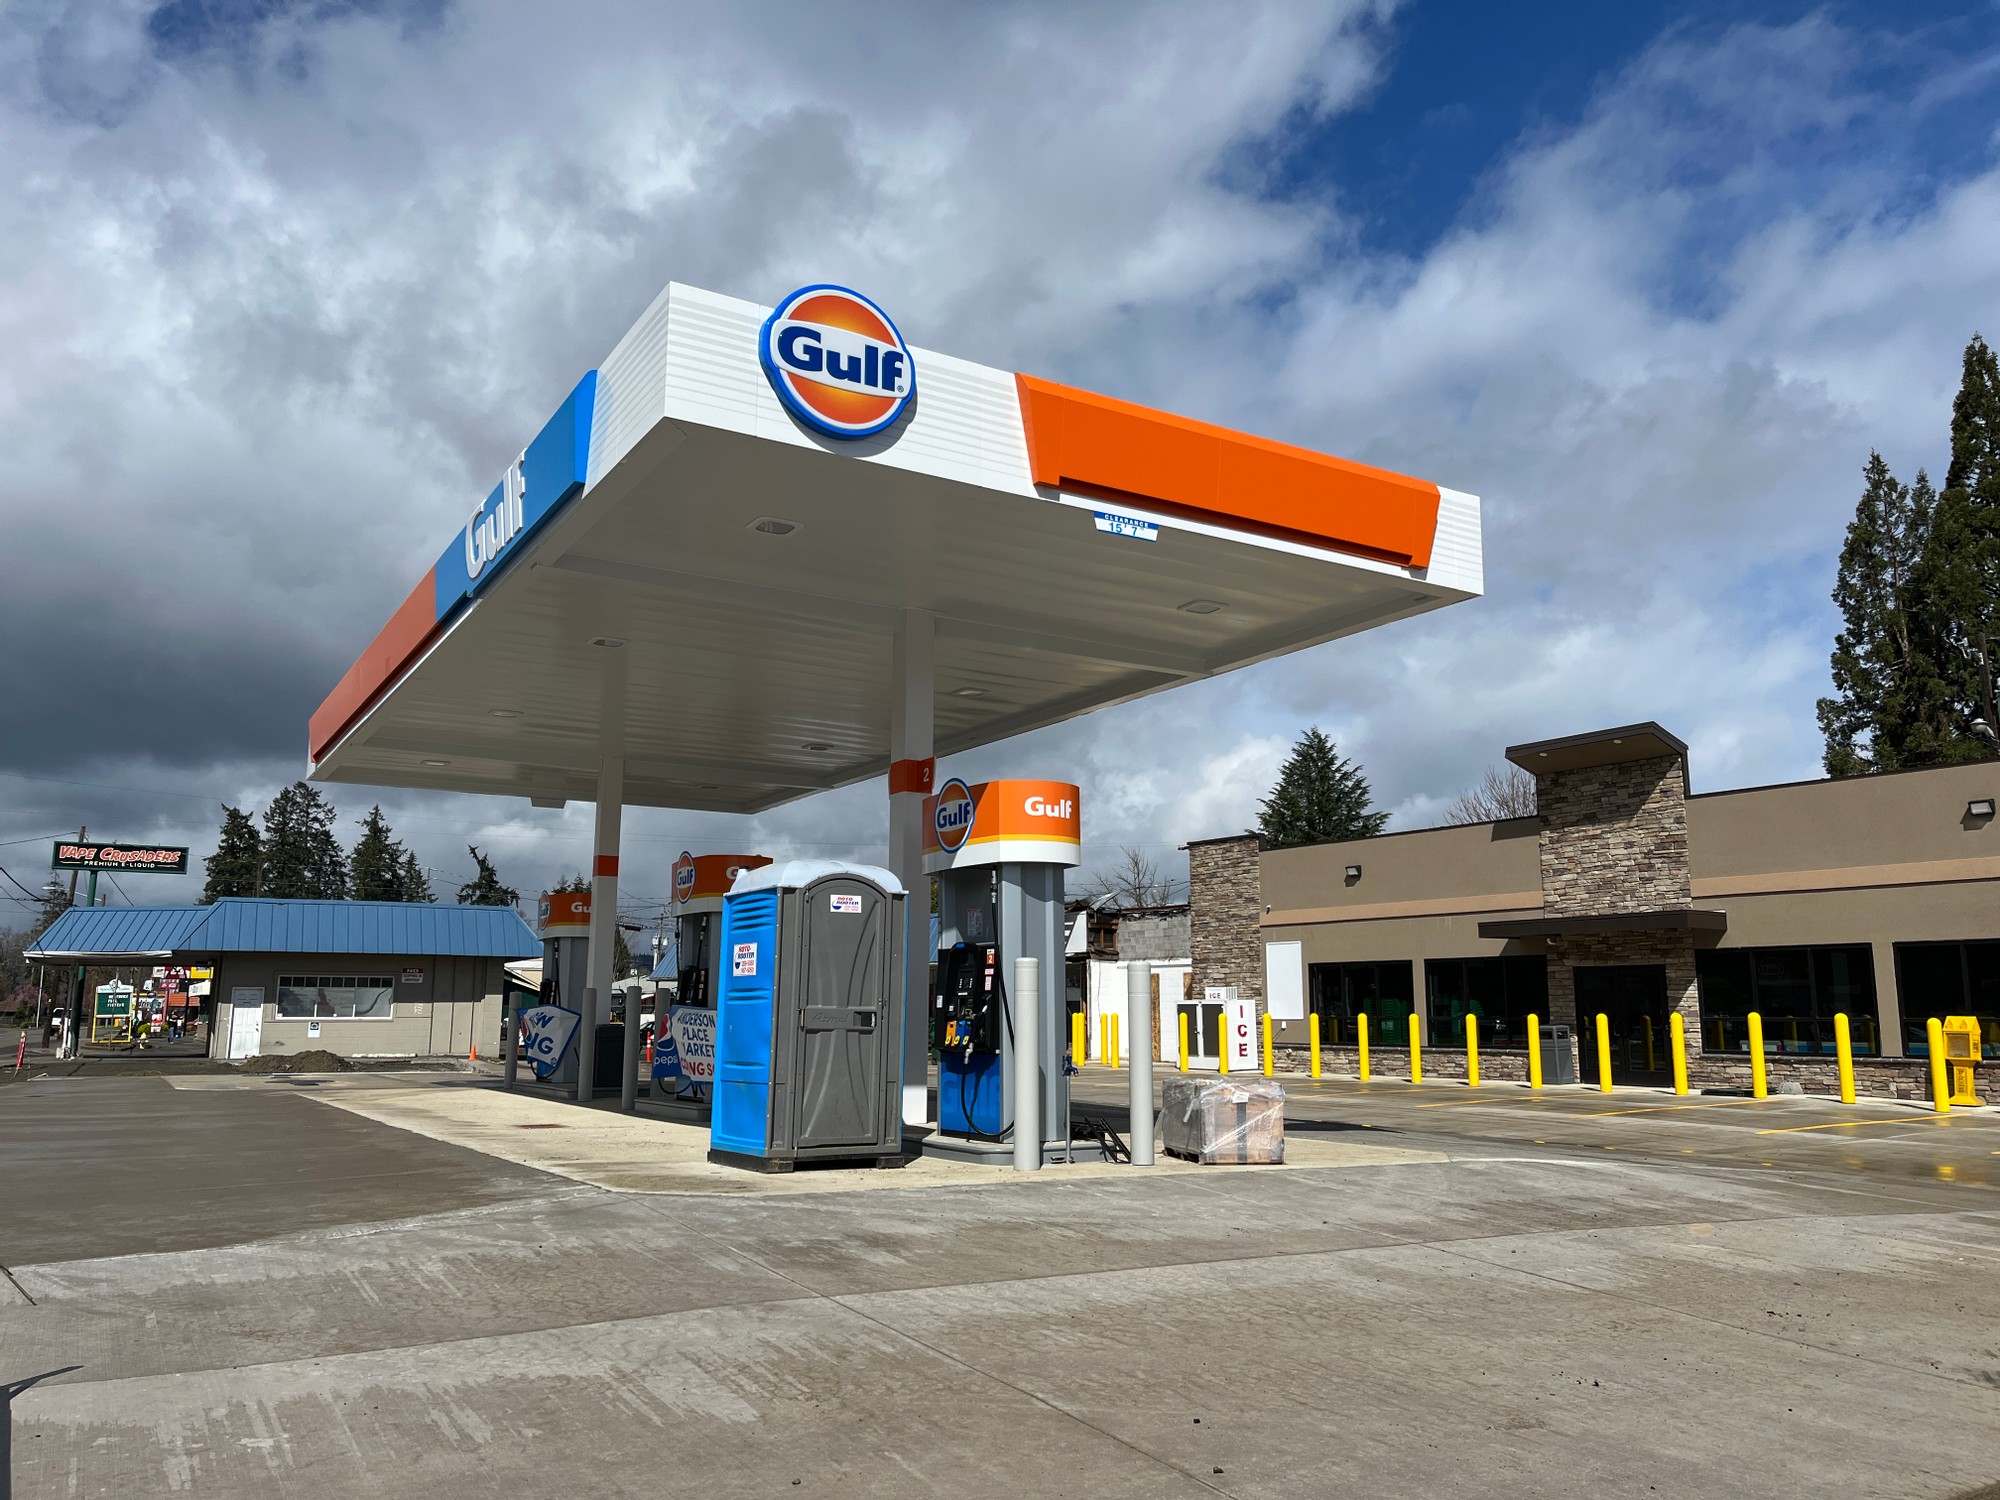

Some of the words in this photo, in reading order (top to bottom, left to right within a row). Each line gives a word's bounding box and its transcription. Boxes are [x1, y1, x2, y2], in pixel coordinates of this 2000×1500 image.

[777, 325, 905, 393] Gulf
[465, 447, 527, 580] Gulf
[1104, 514, 1149, 529] CLEARANCE
[923, 767, 930, 783] 2
[937, 801, 971, 829] Gulf
[1024, 796, 1072, 819] Gulf
[59, 845, 97, 859] VAPE
[99, 847, 181, 863] CRUSADERS
[677, 868, 694, 887] Gulf
[570, 901, 592, 913] Gu
[988, 954, 994, 963] 2
[1237, 1005, 1249, 1057] ICE
